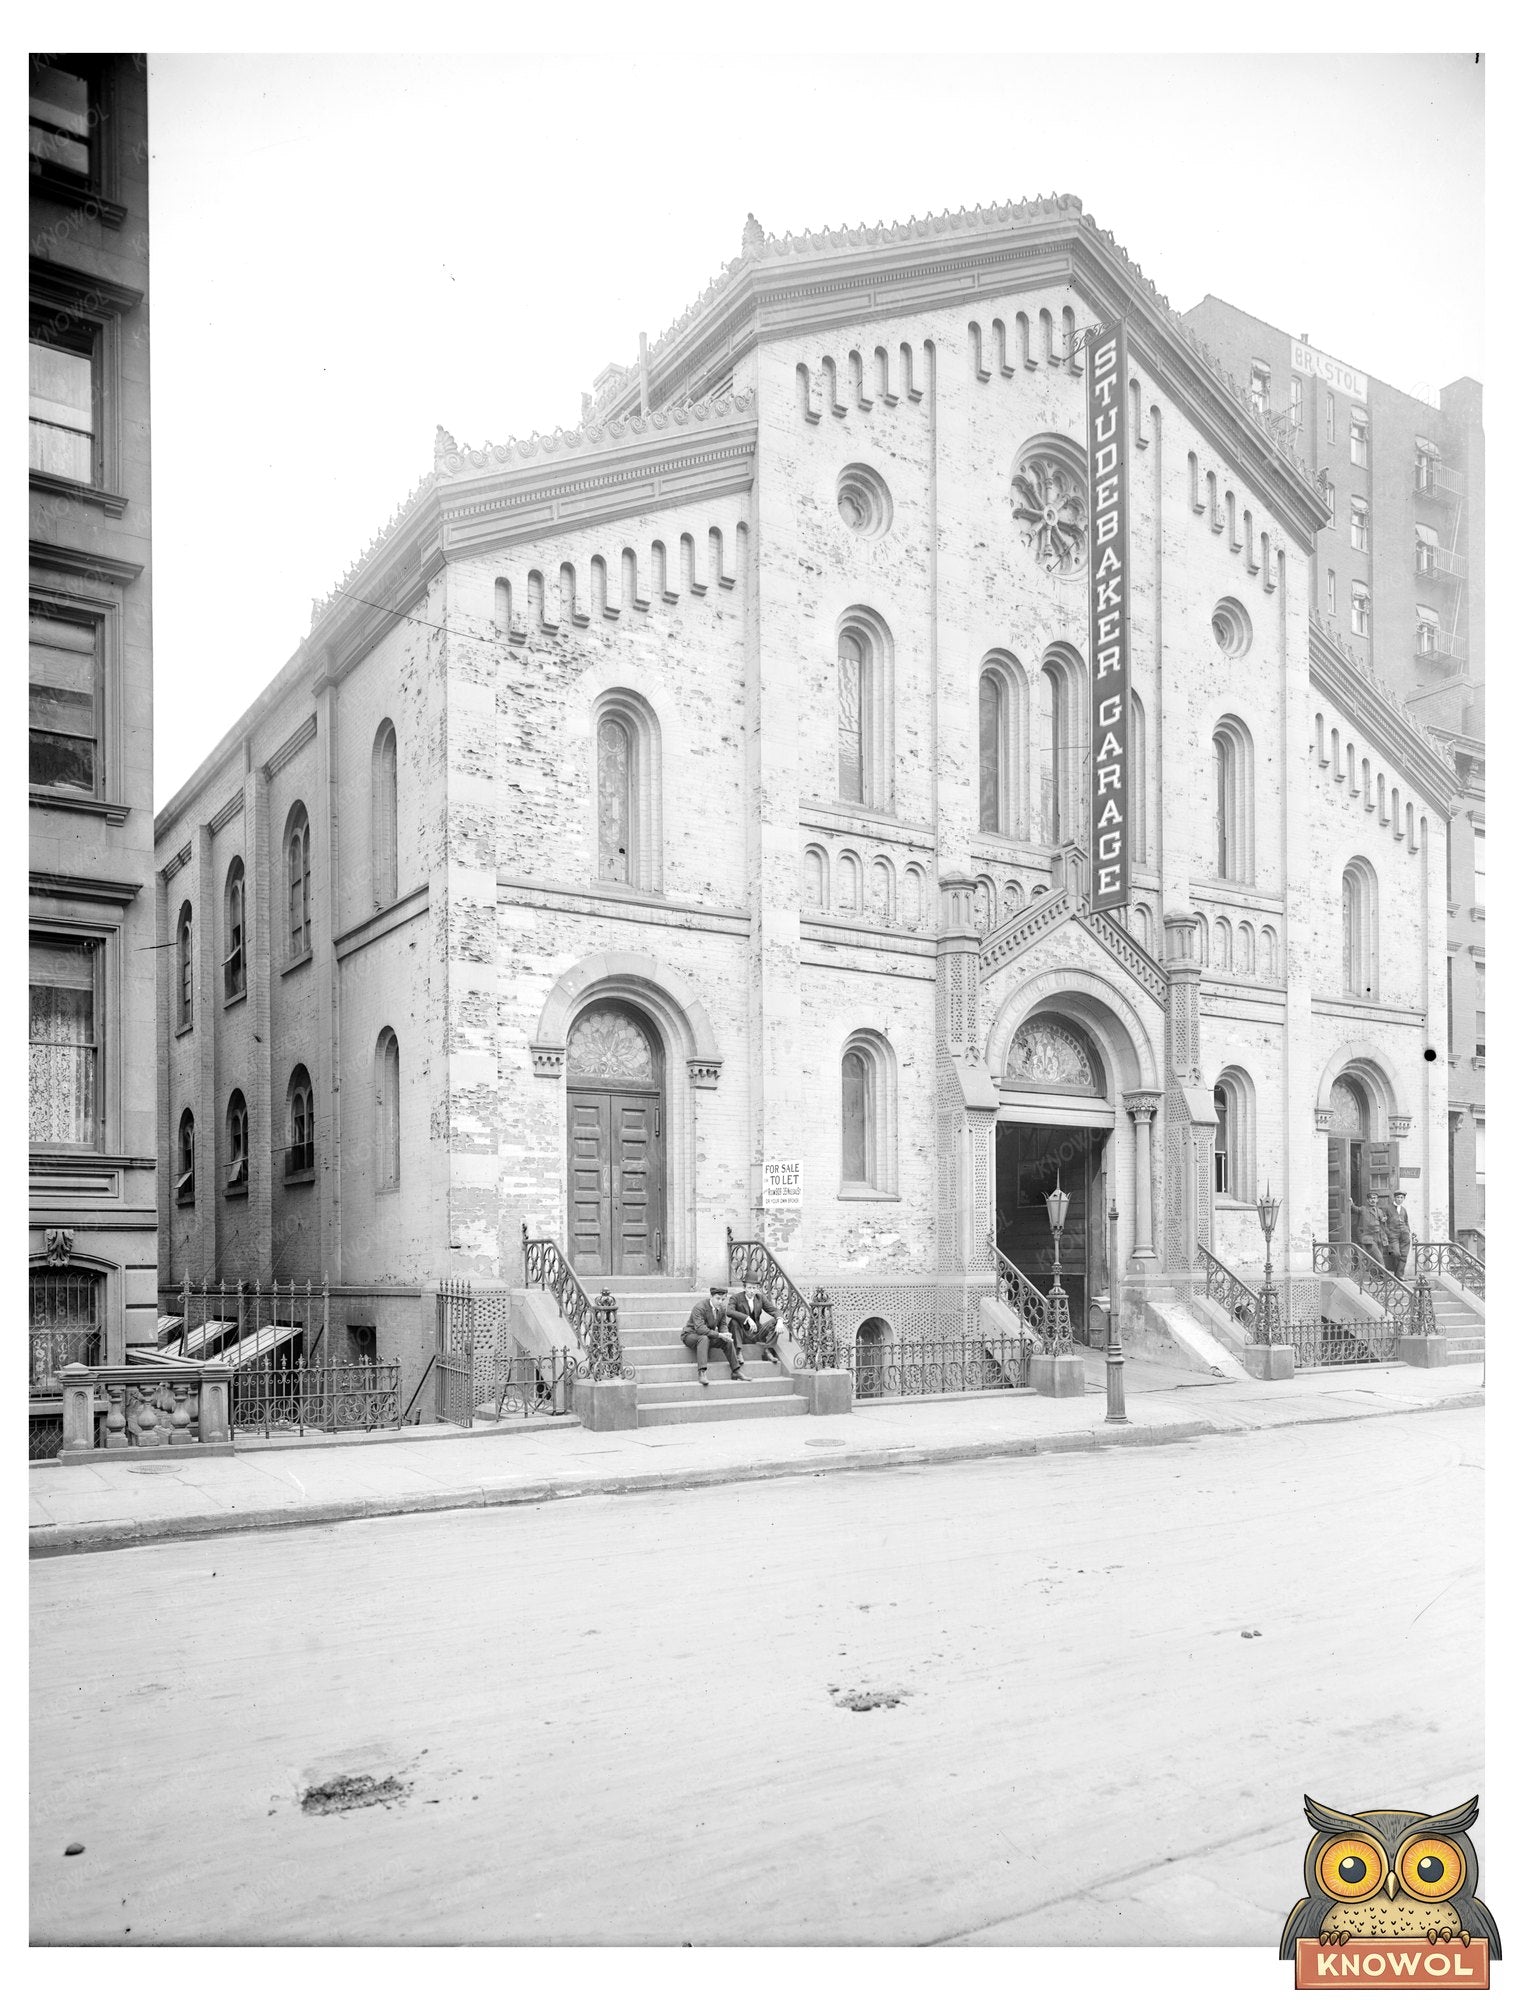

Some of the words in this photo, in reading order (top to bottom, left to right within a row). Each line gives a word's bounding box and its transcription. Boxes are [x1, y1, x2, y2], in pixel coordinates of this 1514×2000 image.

[1295, 346, 1362, 396] BRISTOL
[1094, 338, 1122, 680] STUDEBAKER
[1096, 693, 1123, 896] GARAGE
[765, 1164, 779, 1174] FOR
[781, 1163, 799, 1173] SALE
[770, 1175, 780, 1185] TO
[782, 1174, 799, 1185] LET
